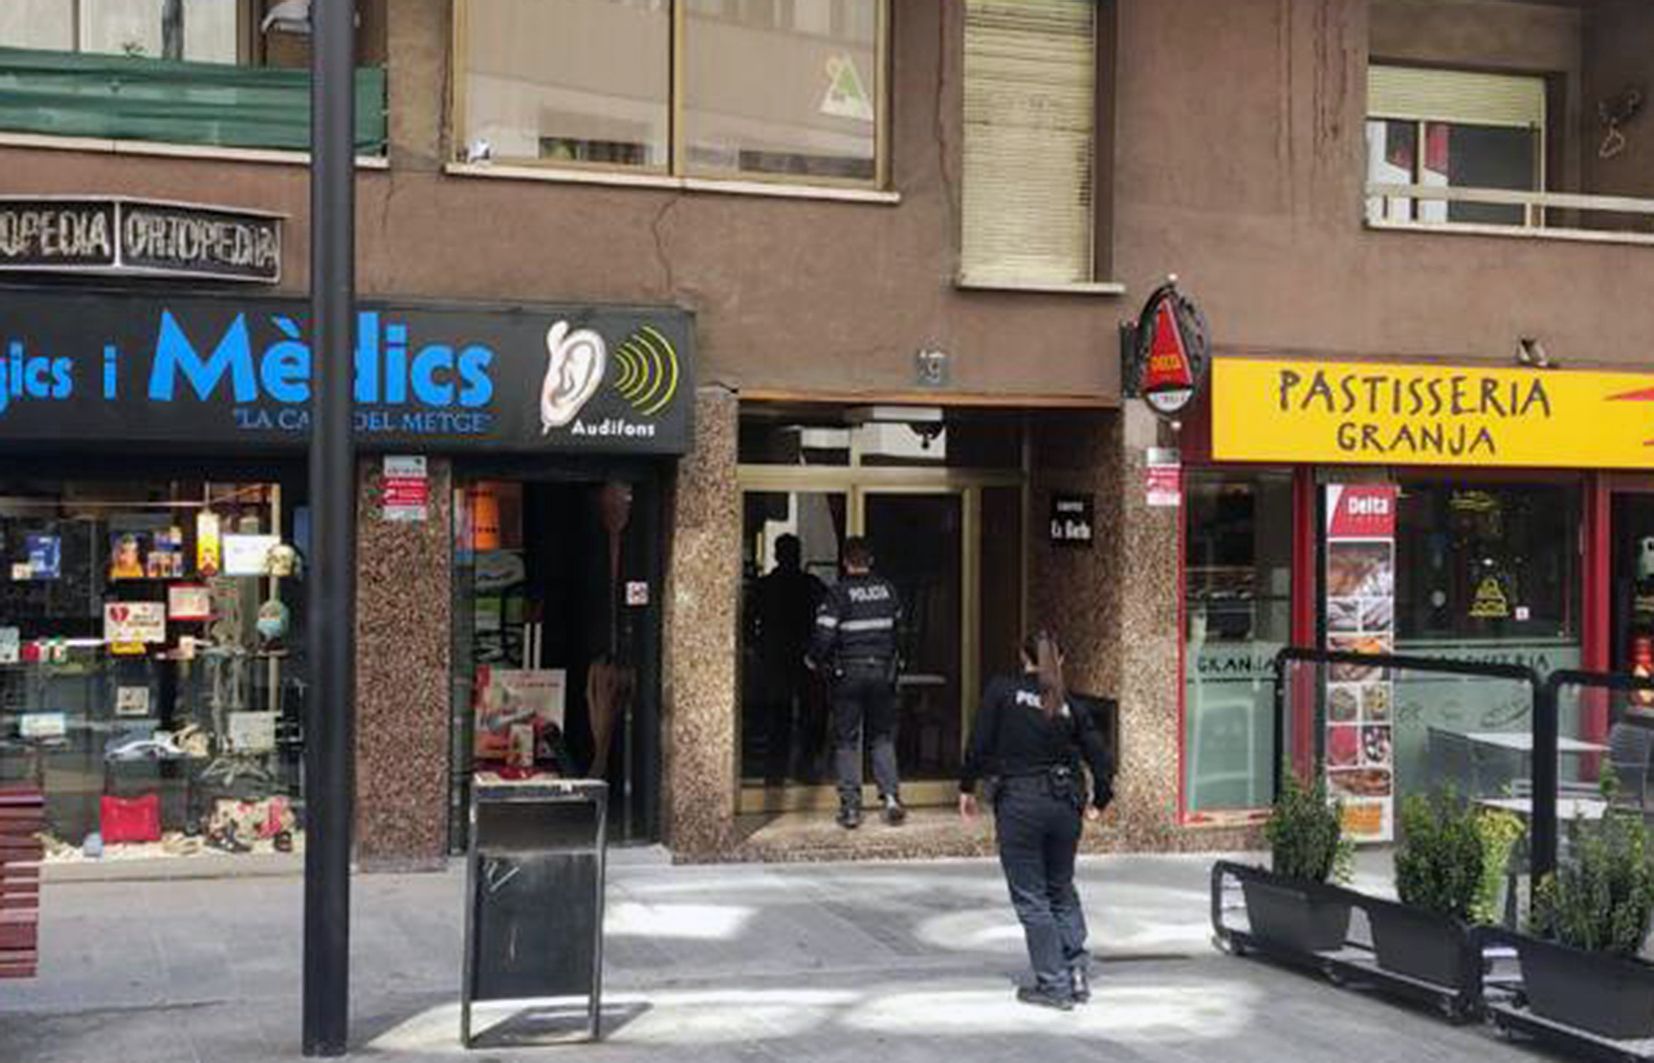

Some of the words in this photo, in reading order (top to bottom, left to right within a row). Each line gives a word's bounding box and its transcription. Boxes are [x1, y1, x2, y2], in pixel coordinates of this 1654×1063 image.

[127, 211, 279, 269] ORTOPEDIA
[103, 345, 117, 400] i
[1278, 368, 1552, 419] PASTISSERIA
[1336, 421, 1497, 457] GRANJA
[1348, 495, 1389, 515] Delta
